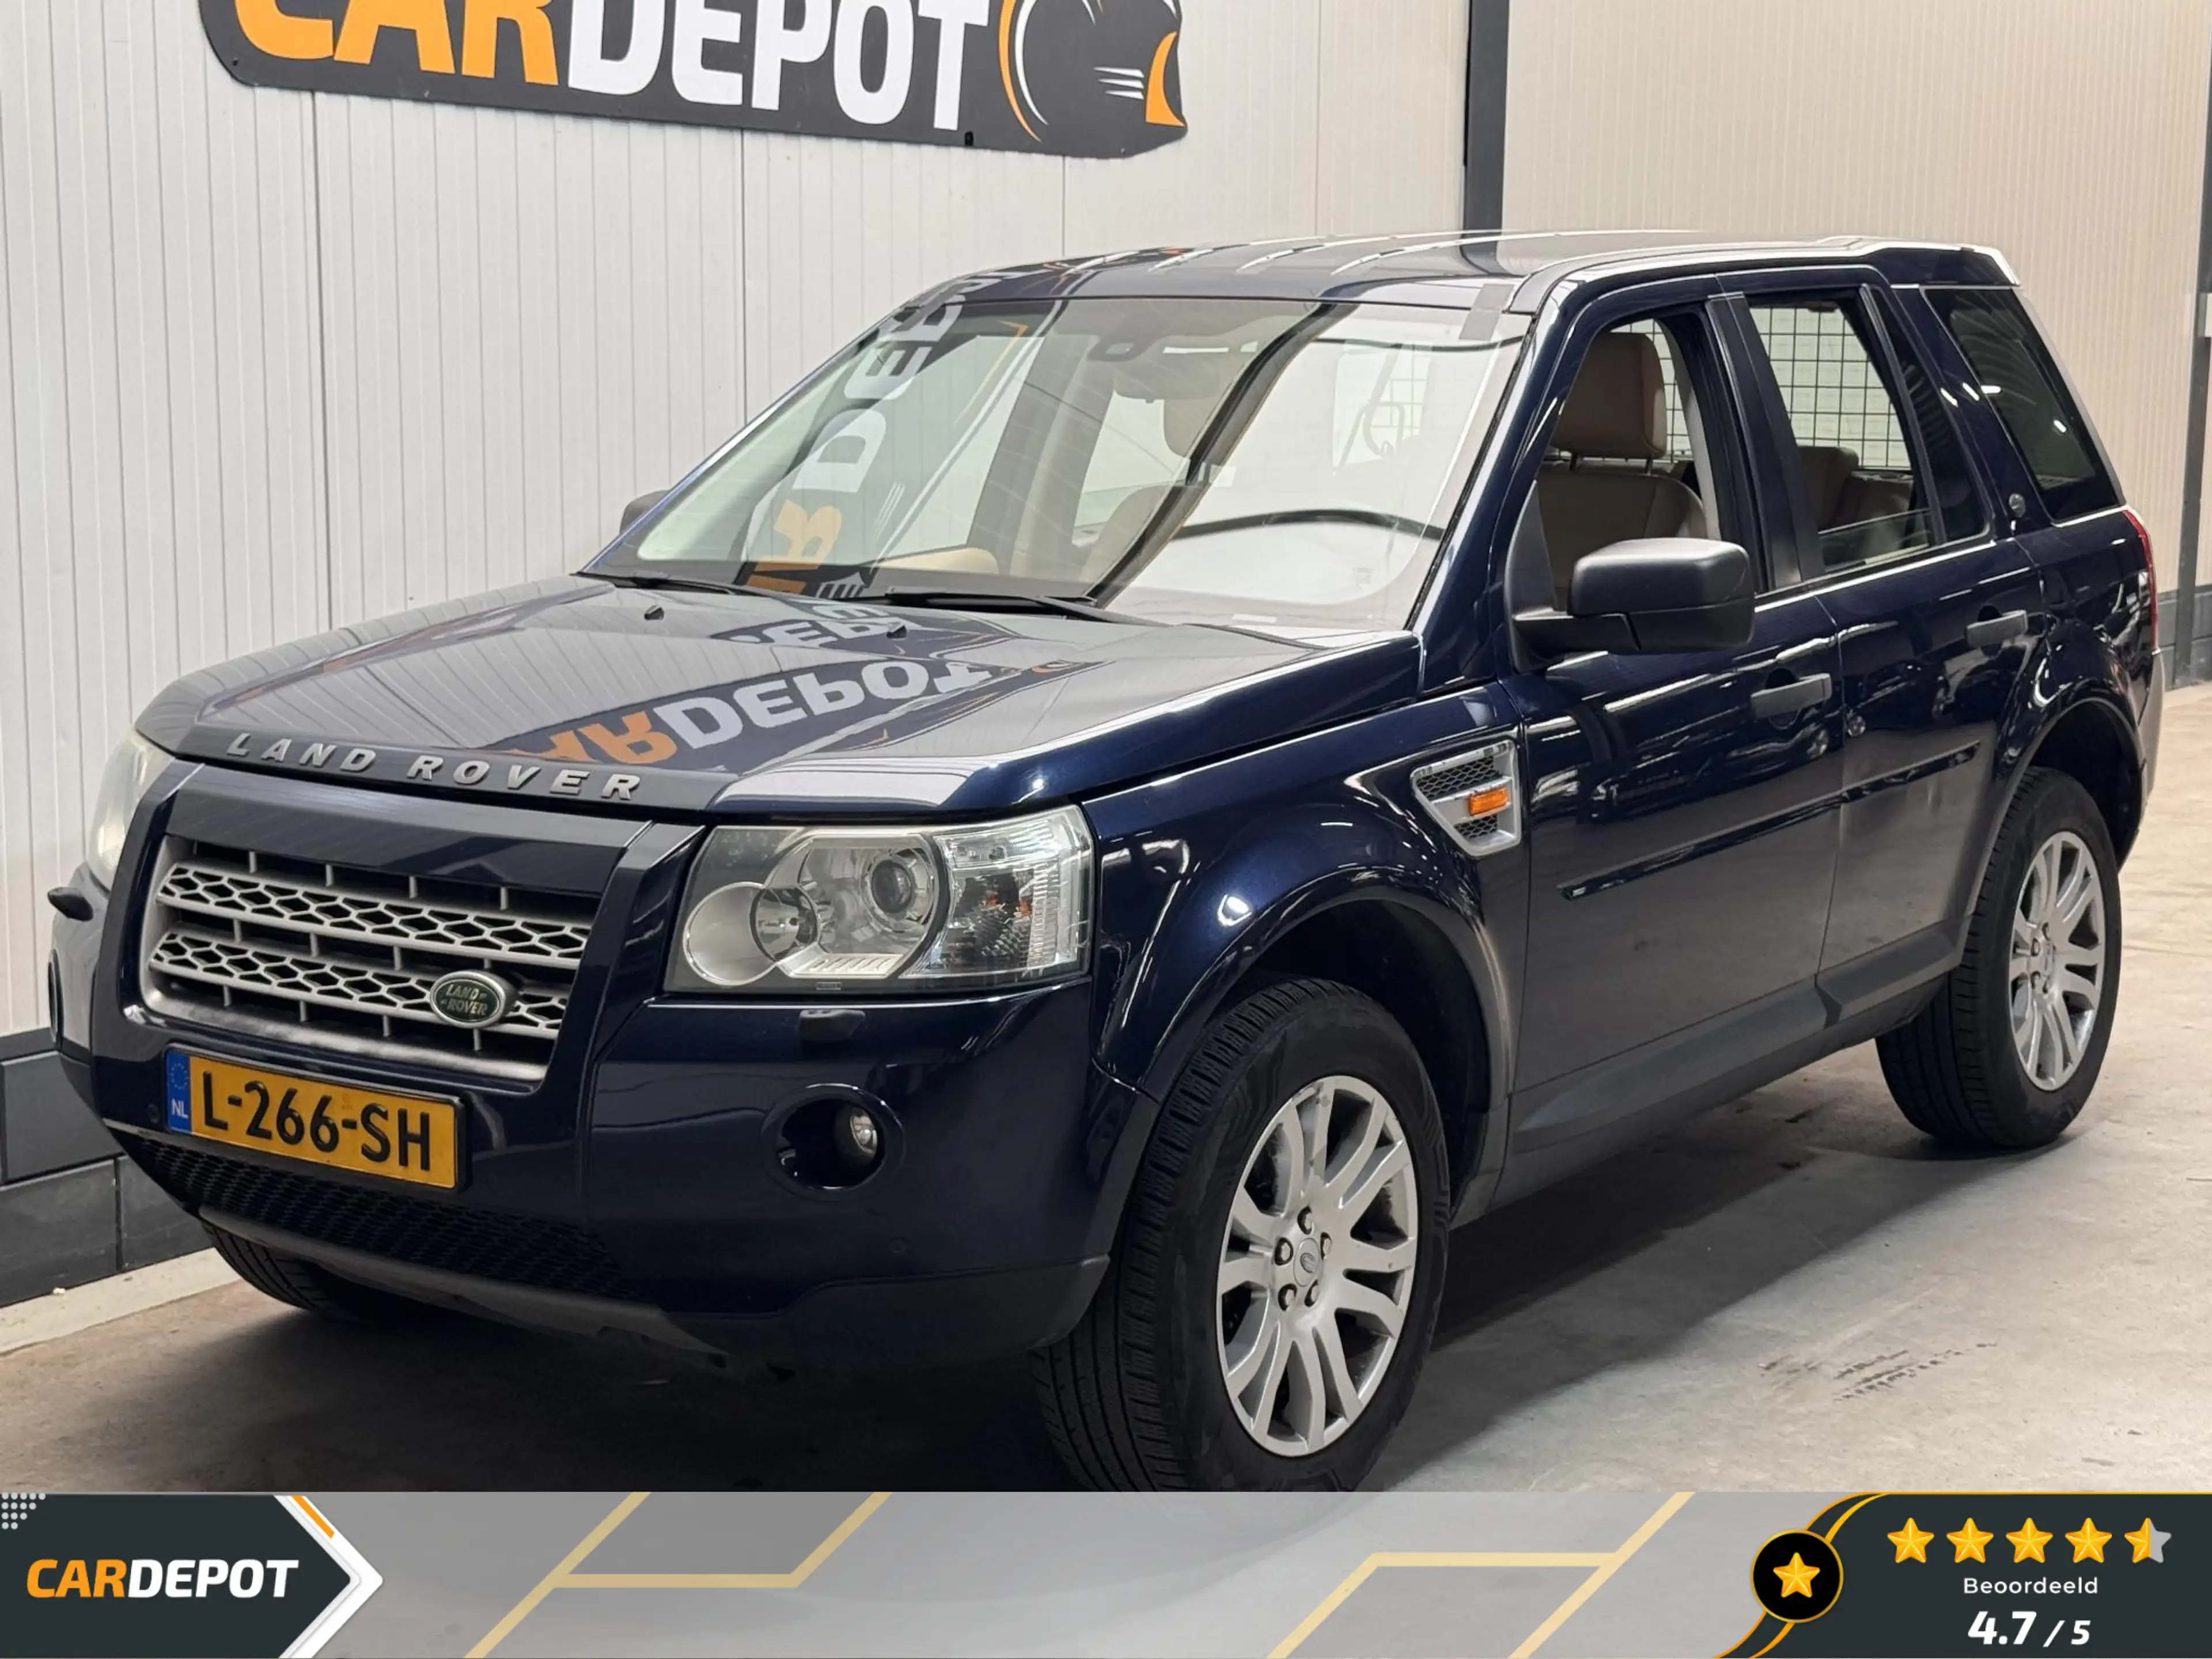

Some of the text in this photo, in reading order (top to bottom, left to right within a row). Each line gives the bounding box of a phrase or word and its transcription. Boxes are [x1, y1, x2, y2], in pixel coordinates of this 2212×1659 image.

[226, 733, 641, 800] LAND ROVER
[445, 983, 479, 1000] LAND
[446, 998, 488, 1016] ROVER
[171, 1098, 188, 1120] NL
[203, 1070, 430, 1171] L-266-SH
